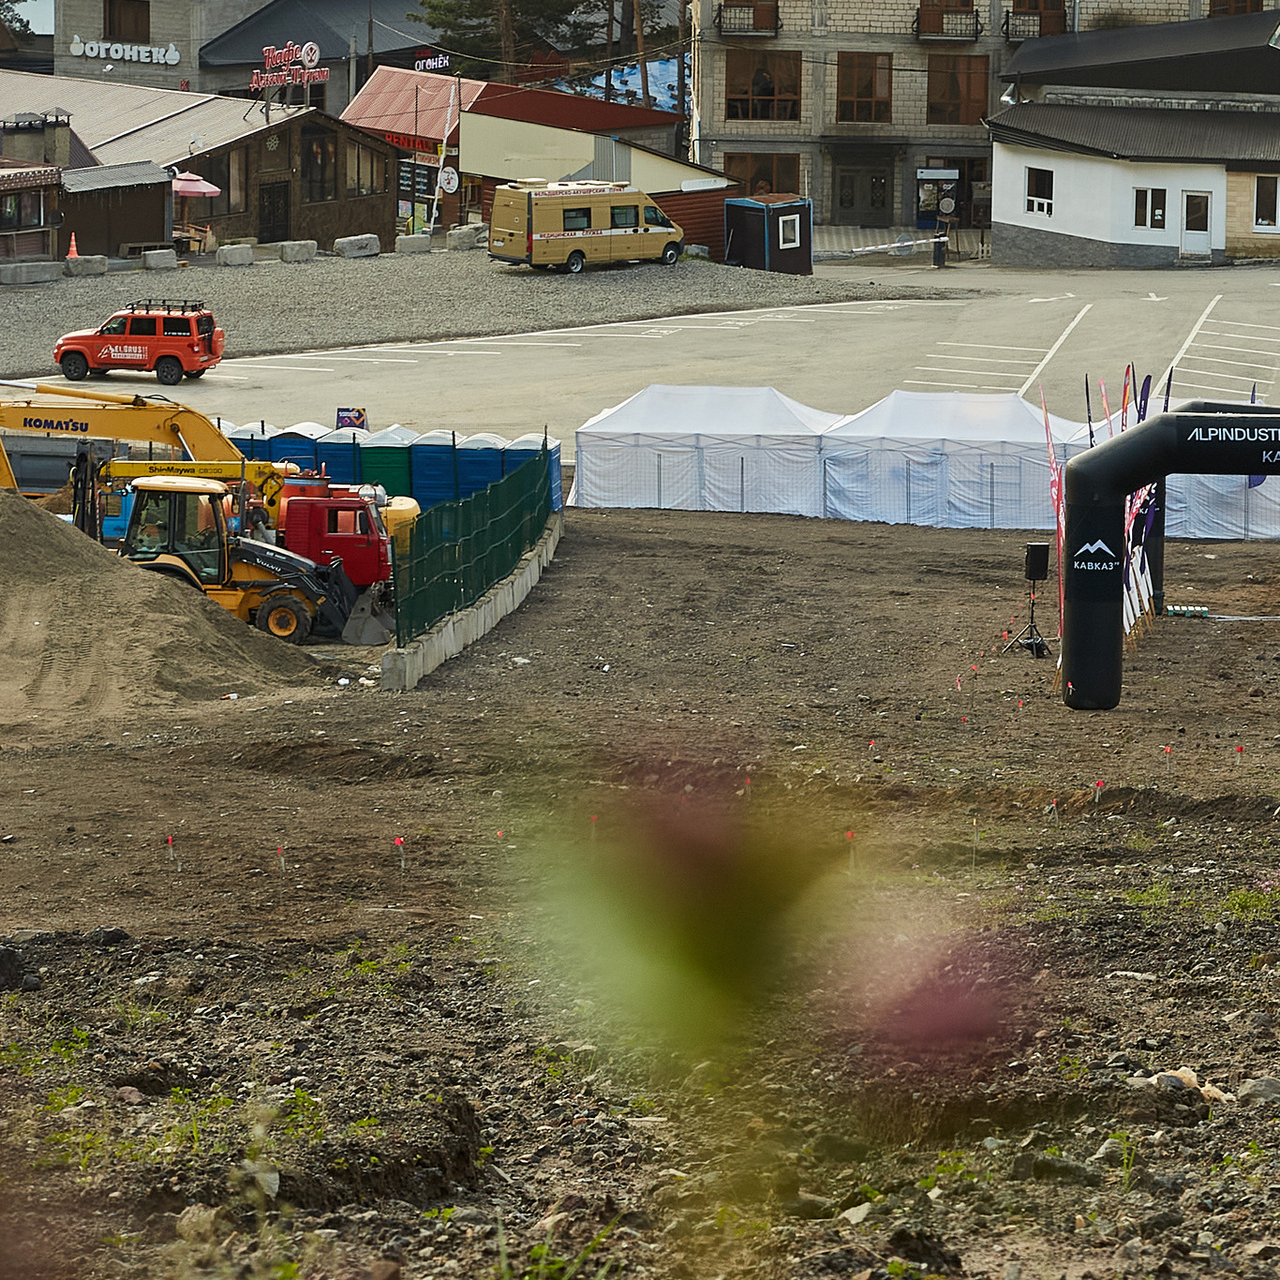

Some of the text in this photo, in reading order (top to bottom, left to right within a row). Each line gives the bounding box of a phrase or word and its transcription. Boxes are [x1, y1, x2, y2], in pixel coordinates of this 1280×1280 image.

[85, 41, 166, 64] ОГОНЕК
[415, 54, 450, 71] ОГОНЁК
[23, 417, 89, 432] KOMATSU
[256, 557, 282, 572] VOLVO
[1073, 560, 1114, 571] КАВКАЗ
